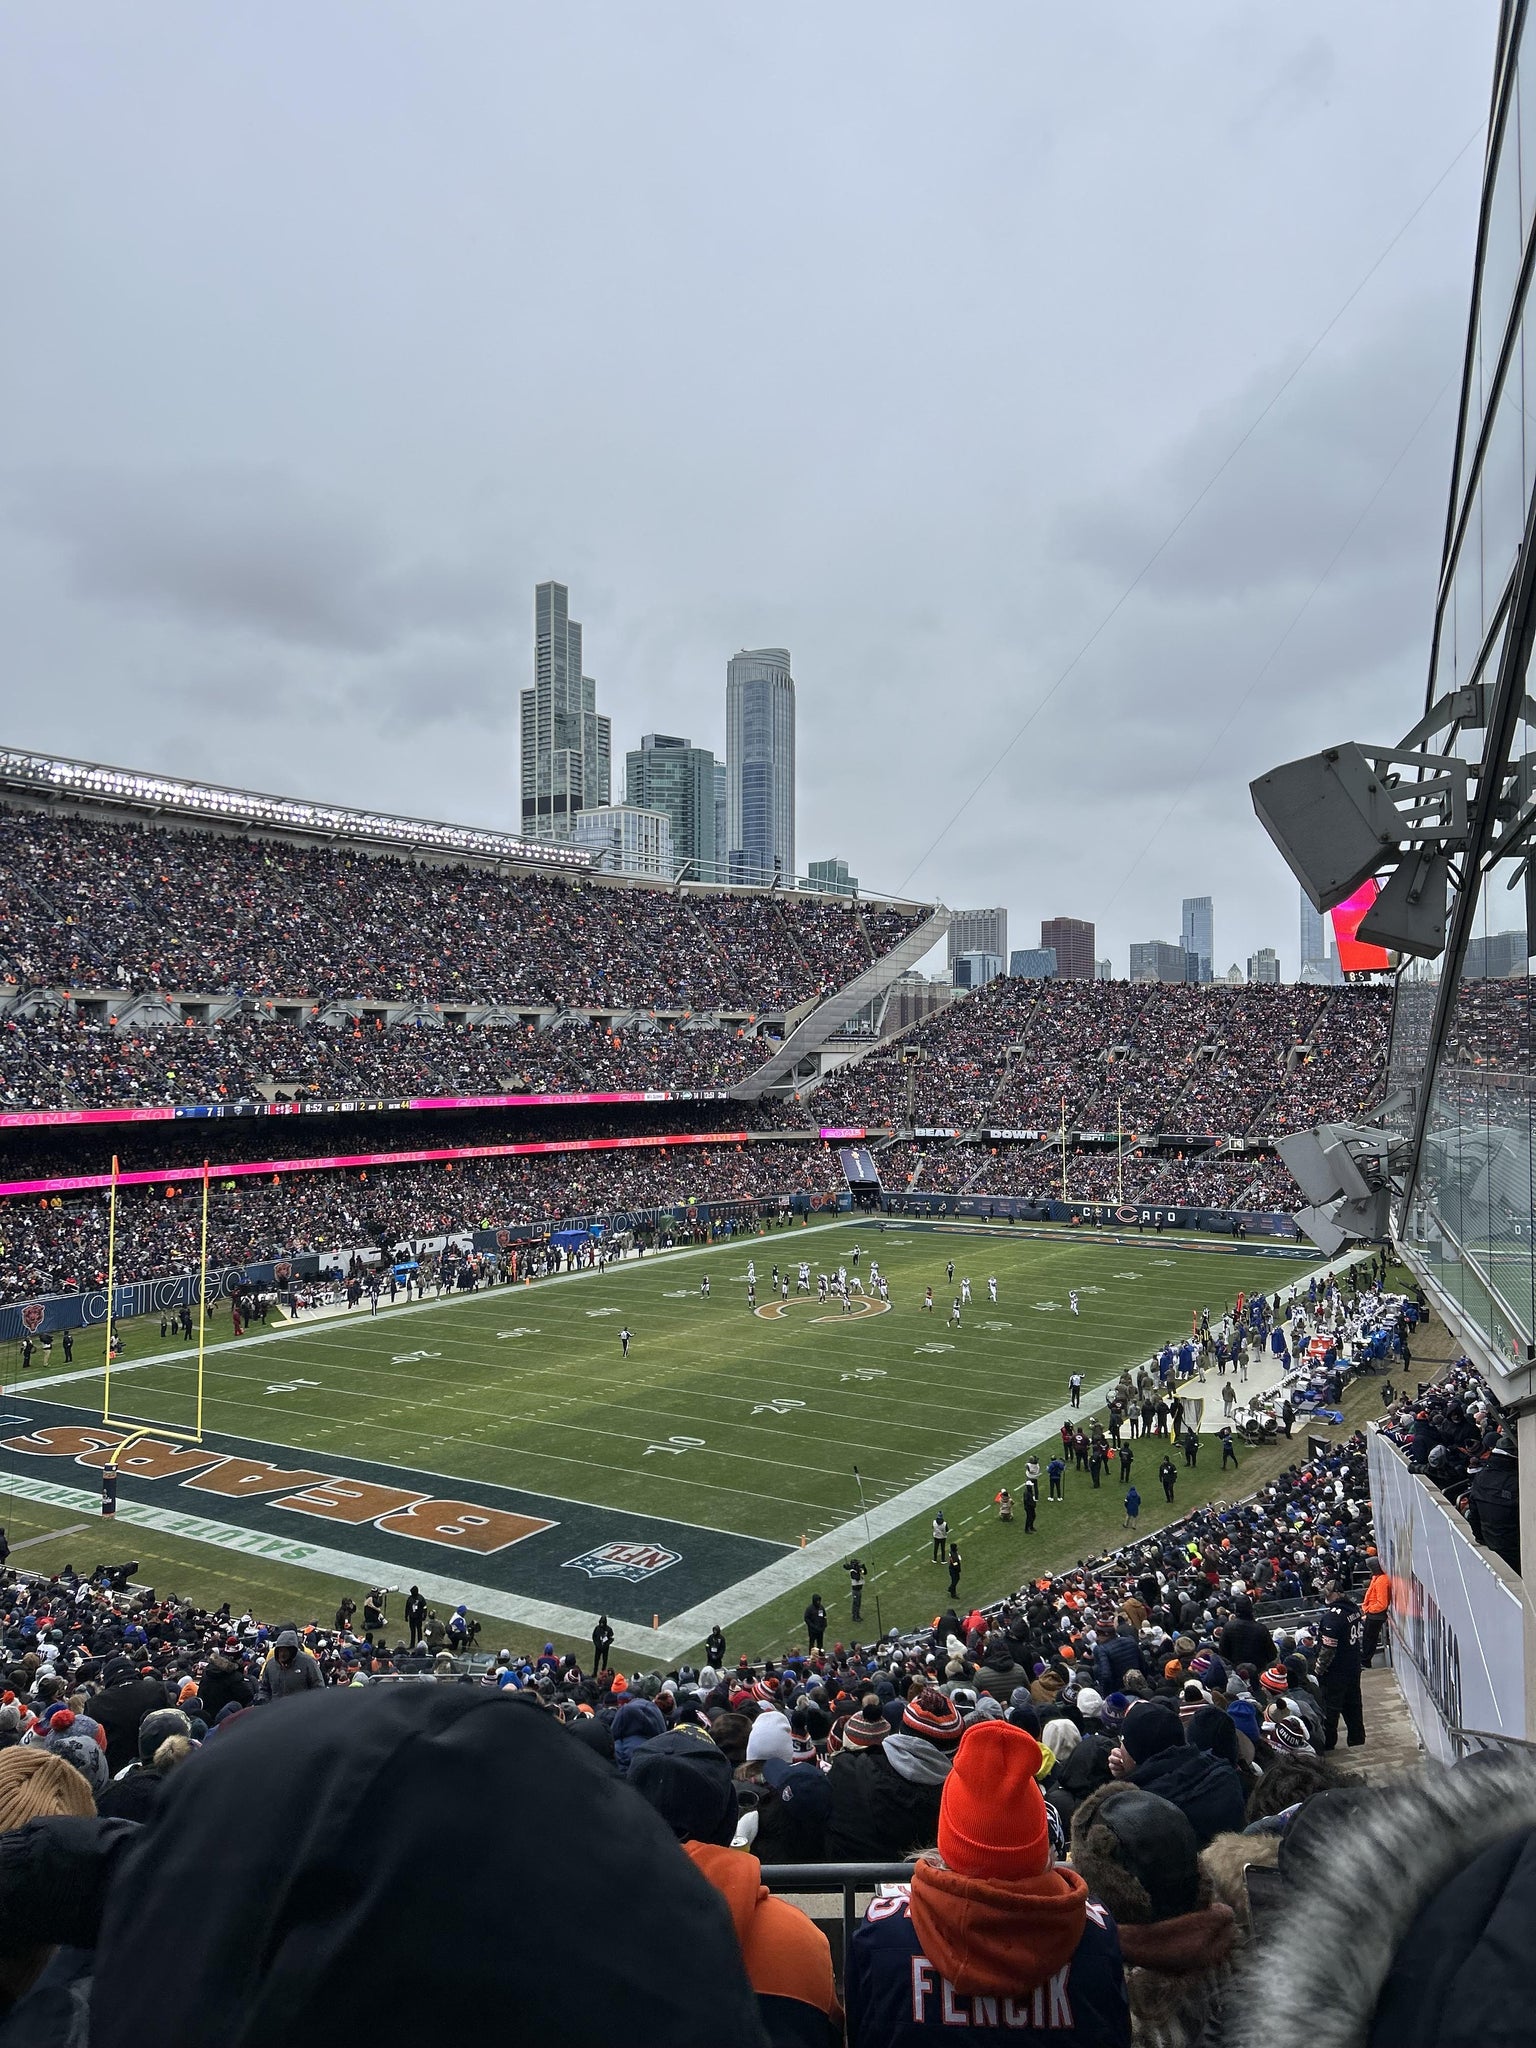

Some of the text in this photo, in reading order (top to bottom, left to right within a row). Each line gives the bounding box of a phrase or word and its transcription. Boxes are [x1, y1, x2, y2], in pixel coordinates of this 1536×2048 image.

[305, 1103, 322, 1113] 8:52
[334, 1102, 340, 1112] 2
[360, 1101, 366, 1111] 2
[377, 1101, 384, 1110] 8
[400, 1100, 409, 1109] 44
[207, 1107, 213, 1117] 7
[254, 1105, 261, 1115] 7
[915, 1128, 956, 1137] BEAR
[990, 1130, 1038, 1139] DOWN
[1080, 1133, 1105, 1141] ESPN
[81, 1266, 243, 1325] CHICAGO
[390, 1350, 442, 1366] 20
[840, 1368, 888, 1382] 30
[262, 1378, 322, 1396] 10
[750, 1398, 807, 1415] 20
[642, 1435, 706, 1456] 10
[0, 1426, 561, 1556] BEARS
[0, 1473, 318, 1560] SALUTE TO SERVIC
[601, 1544, 671, 1569] NFL
